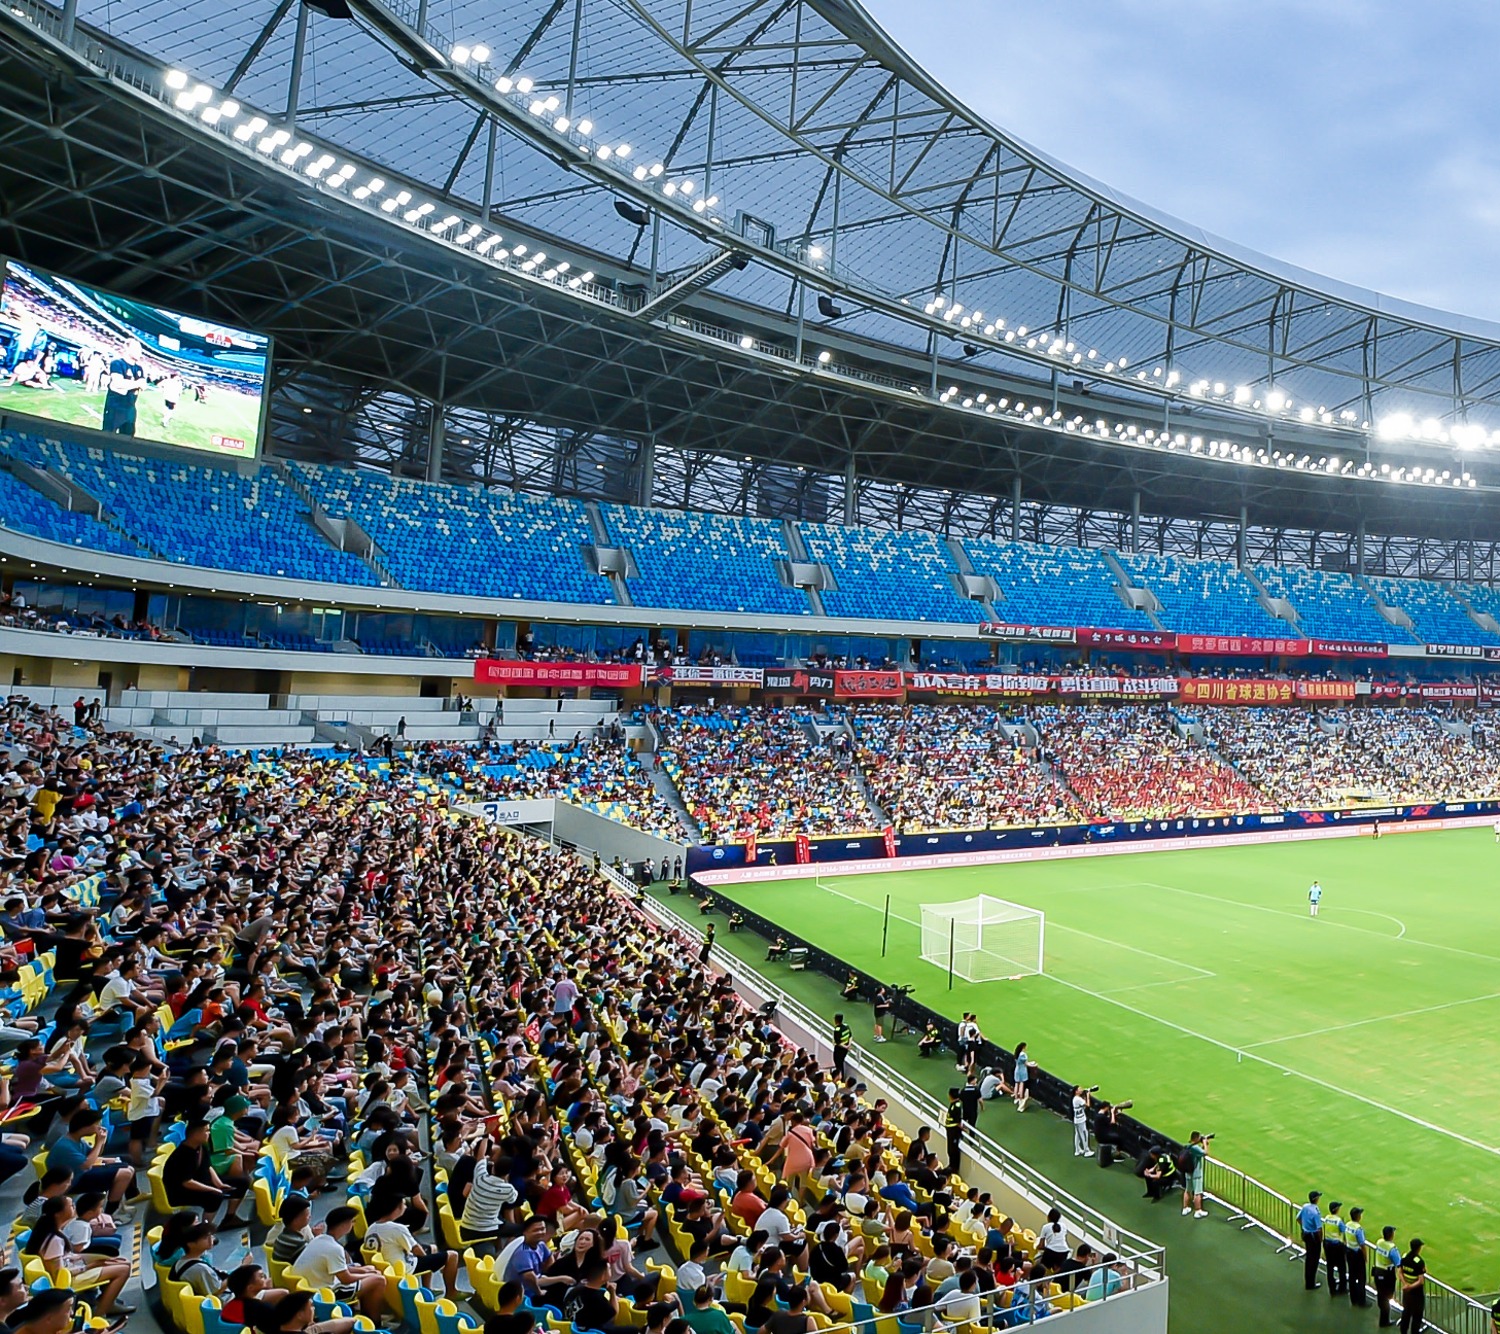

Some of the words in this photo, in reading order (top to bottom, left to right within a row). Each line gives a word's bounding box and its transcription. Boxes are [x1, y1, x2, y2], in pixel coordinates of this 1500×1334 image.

[912, 673, 980, 690] 永不言弃
[1123, 678, 1178, 693] 战斗到底
[1197, 683, 1291, 700] 四川省球迷协会
